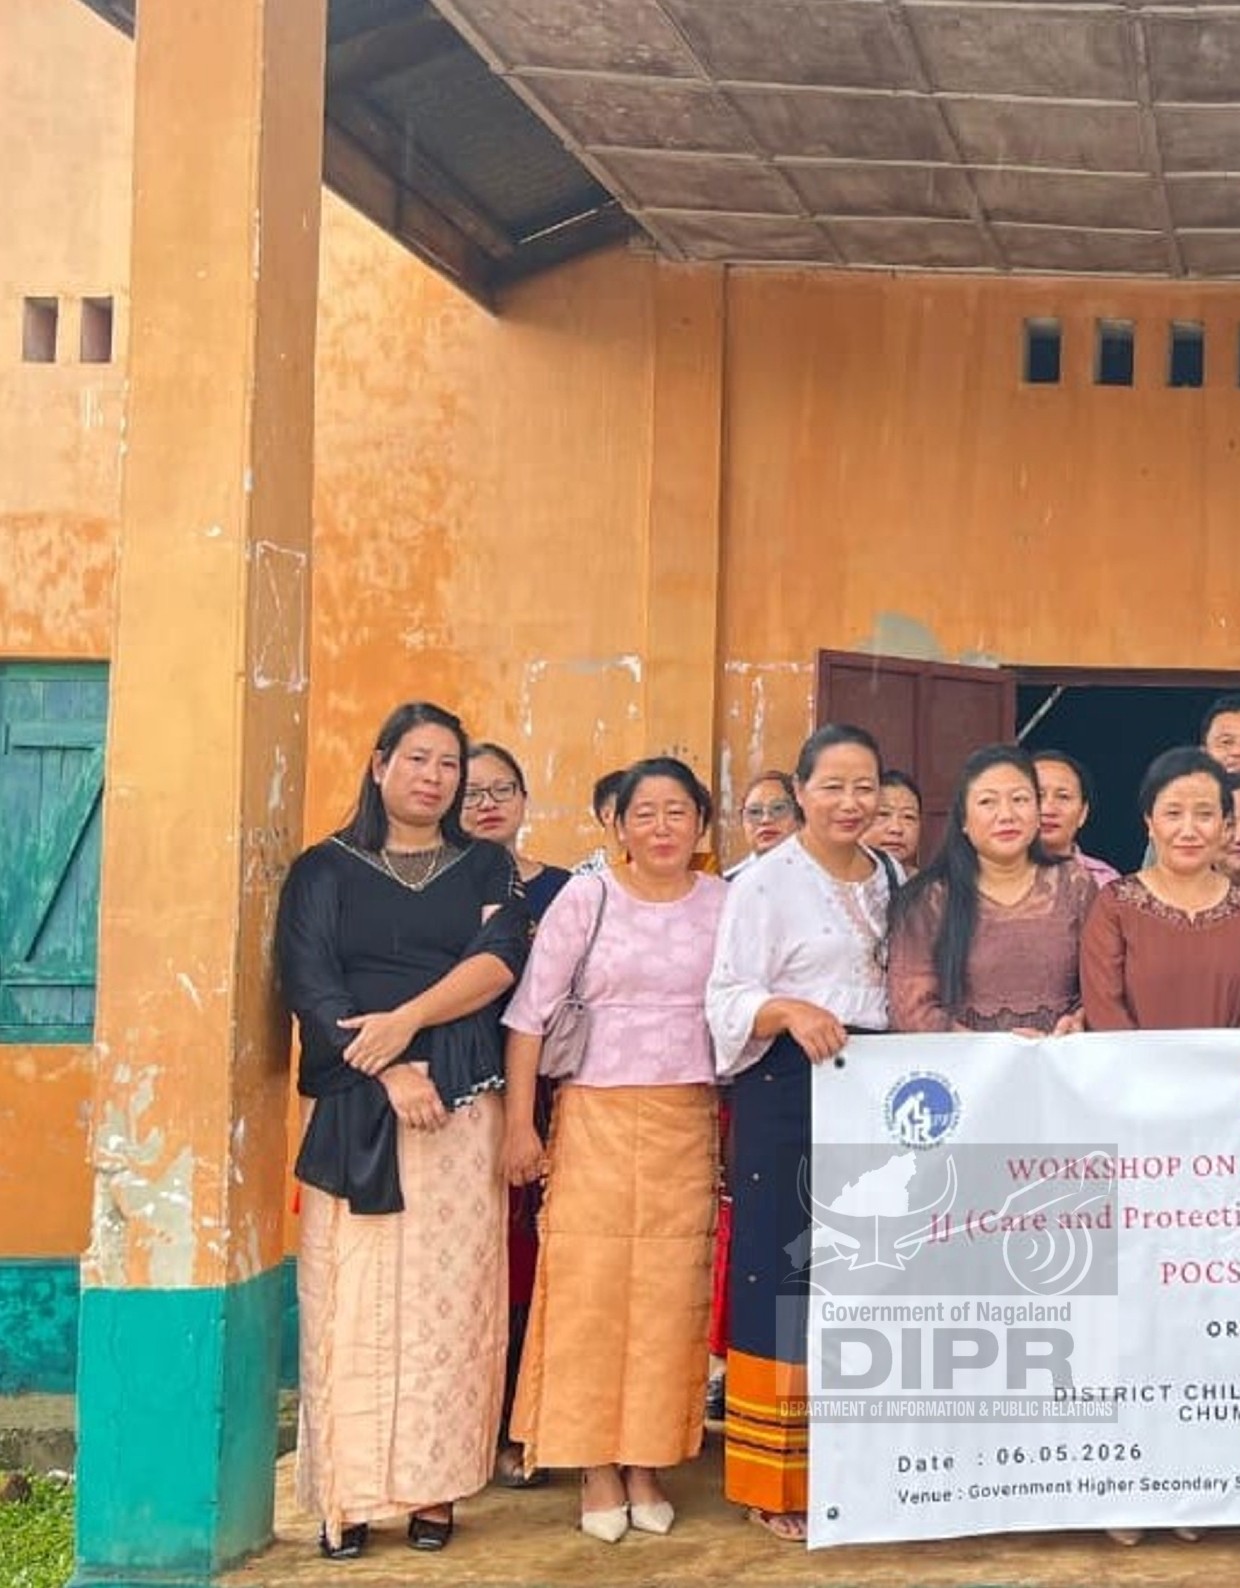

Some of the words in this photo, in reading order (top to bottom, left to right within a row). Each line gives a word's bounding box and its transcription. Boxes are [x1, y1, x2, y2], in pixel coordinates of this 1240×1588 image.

[1007, 1156, 1182, 1181] WORKSHOP
[1192, 1154, 1236, 1177] ON
[966, 1208, 1048, 1240] (Care
[1058, 1203, 1113, 1230] and
[1054, 1384, 1173, 1402] DISTRICT
[898, 1454, 955, 1473] Date
[996, 1443, 1142, 1466] 06.05.2026
[898, 1488, 953, 1505] Venue
[968, 1479, 1072, 1500] Government
[1078, 1477, 1135, 1496] Higher
[1139, 1475, 1229, 1493] Secondary
